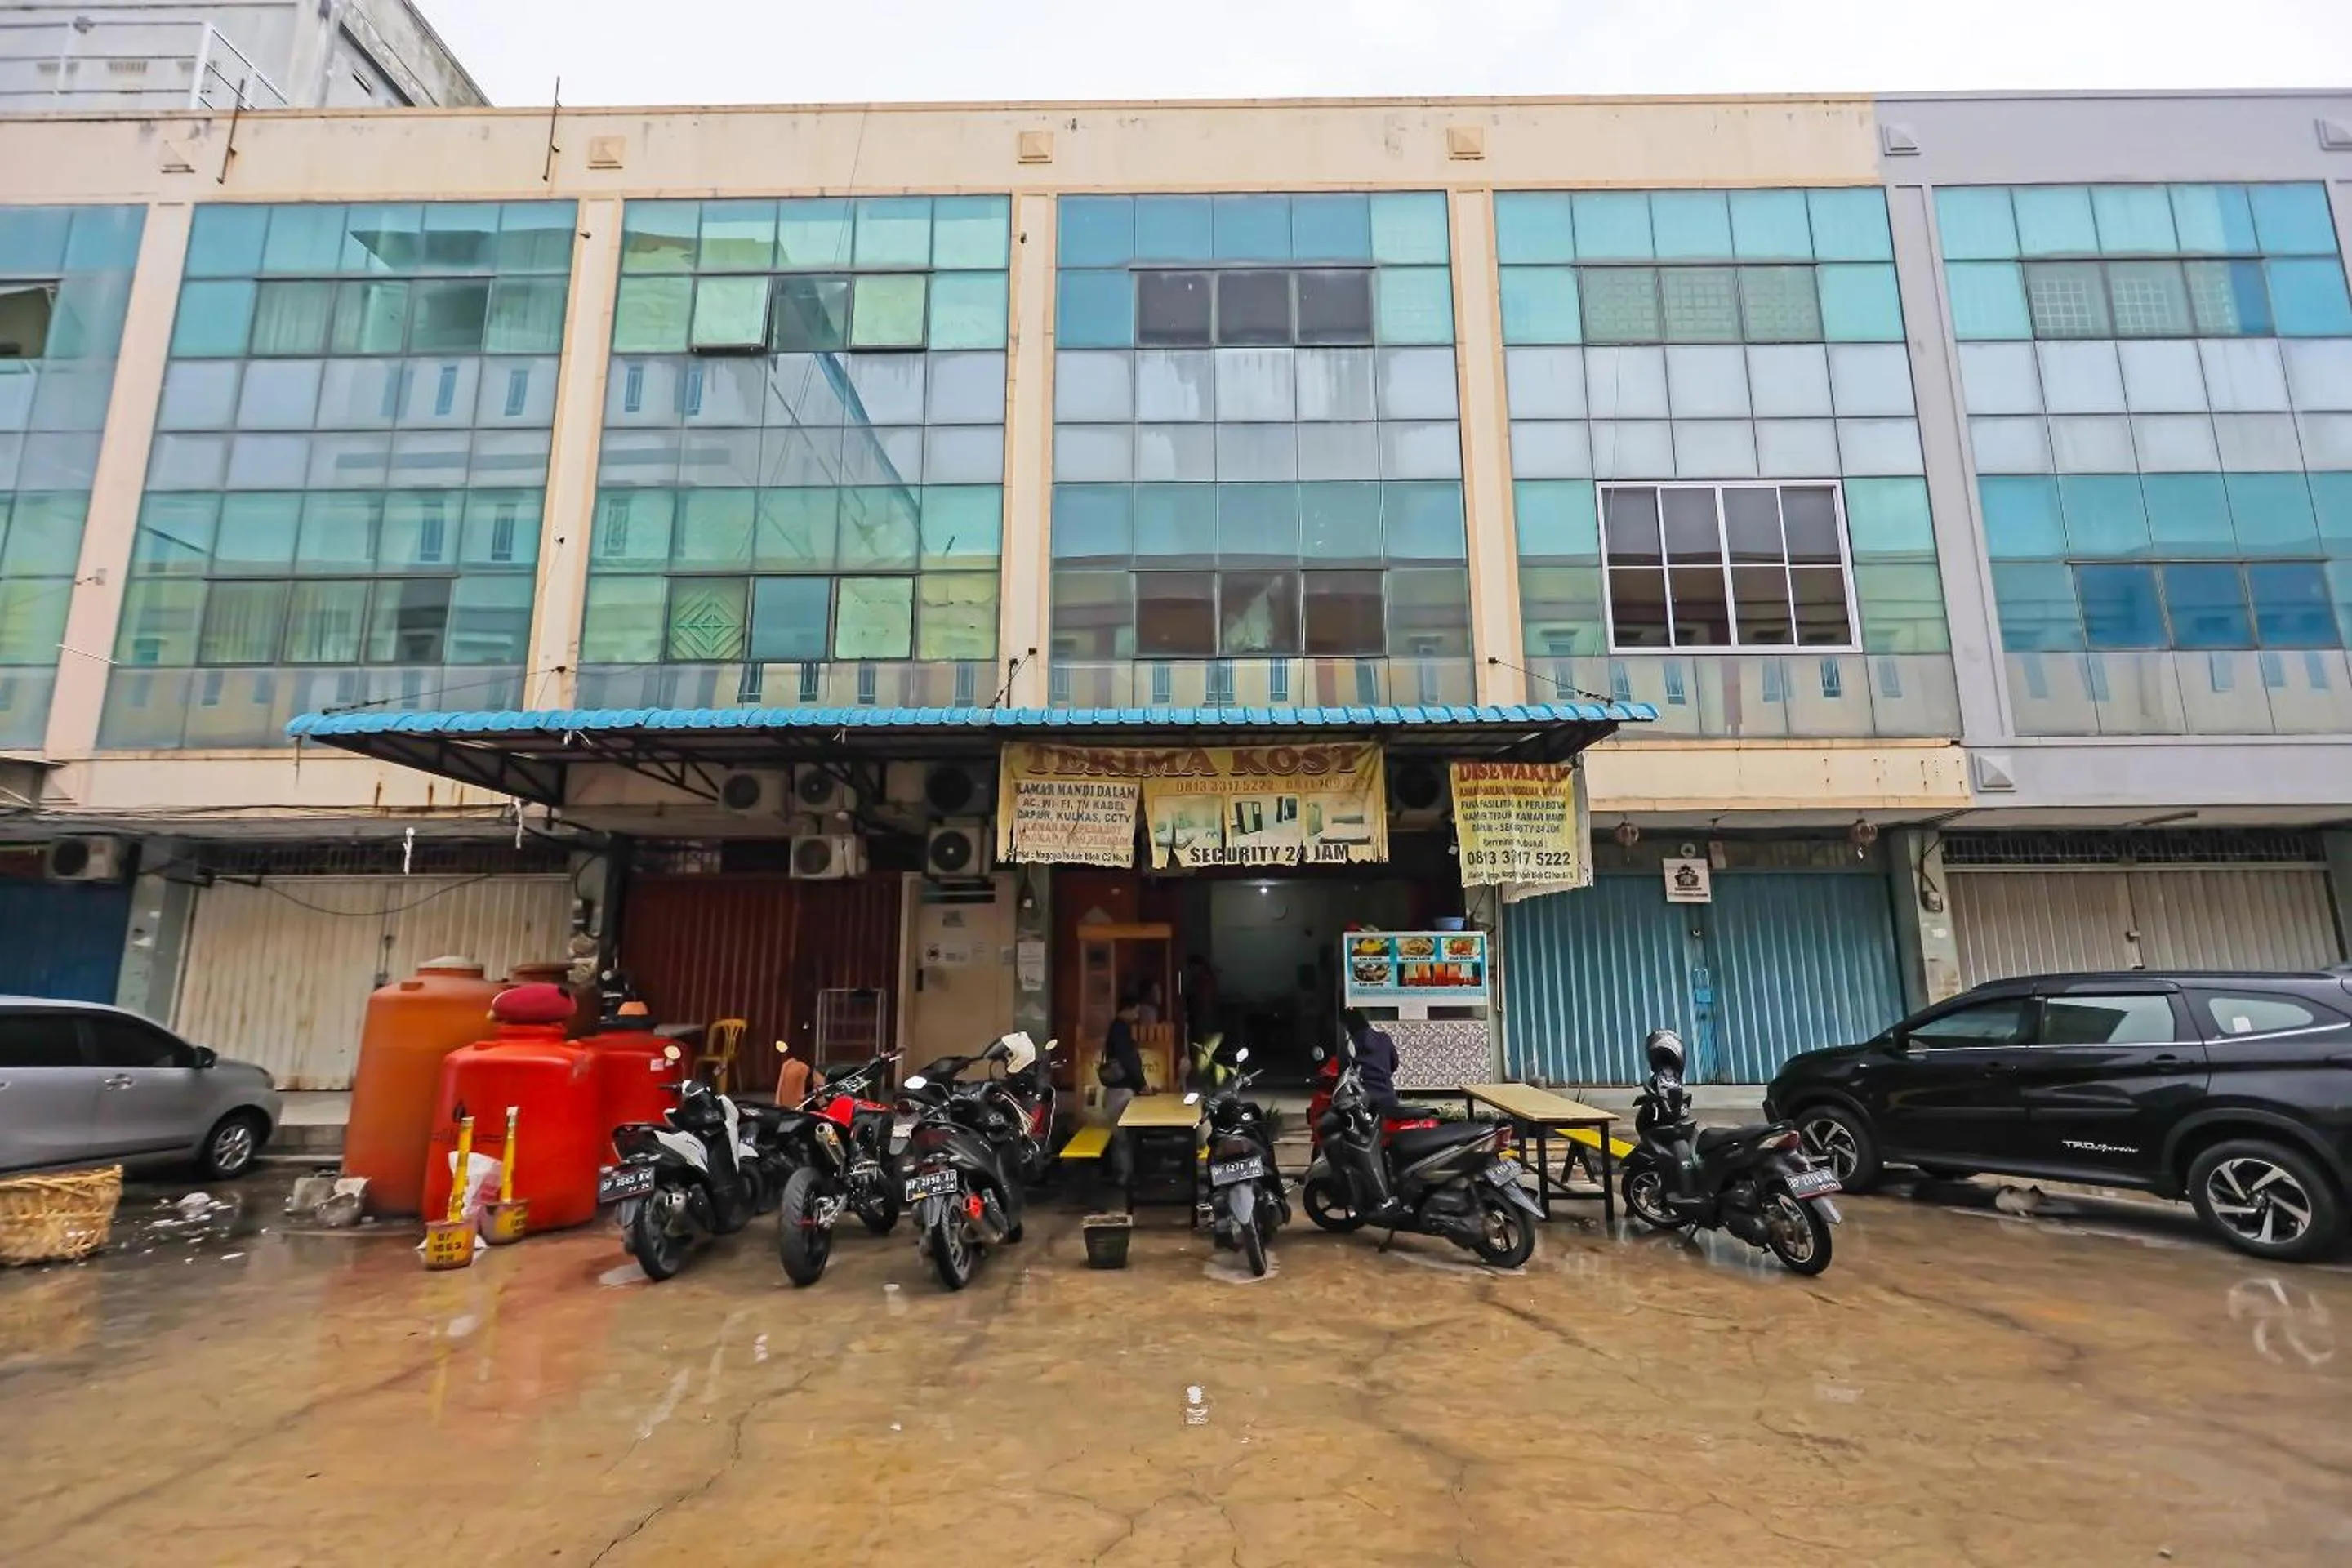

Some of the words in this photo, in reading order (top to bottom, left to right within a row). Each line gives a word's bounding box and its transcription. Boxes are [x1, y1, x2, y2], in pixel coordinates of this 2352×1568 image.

[1026, 746, 1218, 777] TERIMA
[1229, 744, 1363, 776] KOST
[1057, 785, 1094, 797] MANDI
[1097, 786, 1136, 799] DALAM
[1093, 801, 1127, 811] KABEL
[1104, 813, 1131, 824] CCTV
[1189, 845, 1280, 863] SECURITY
[1313, 844, 1348, 861] JAM
[1467, 850, 1497, 866] 0813
[1535, 851, 1571, 866] 5222
